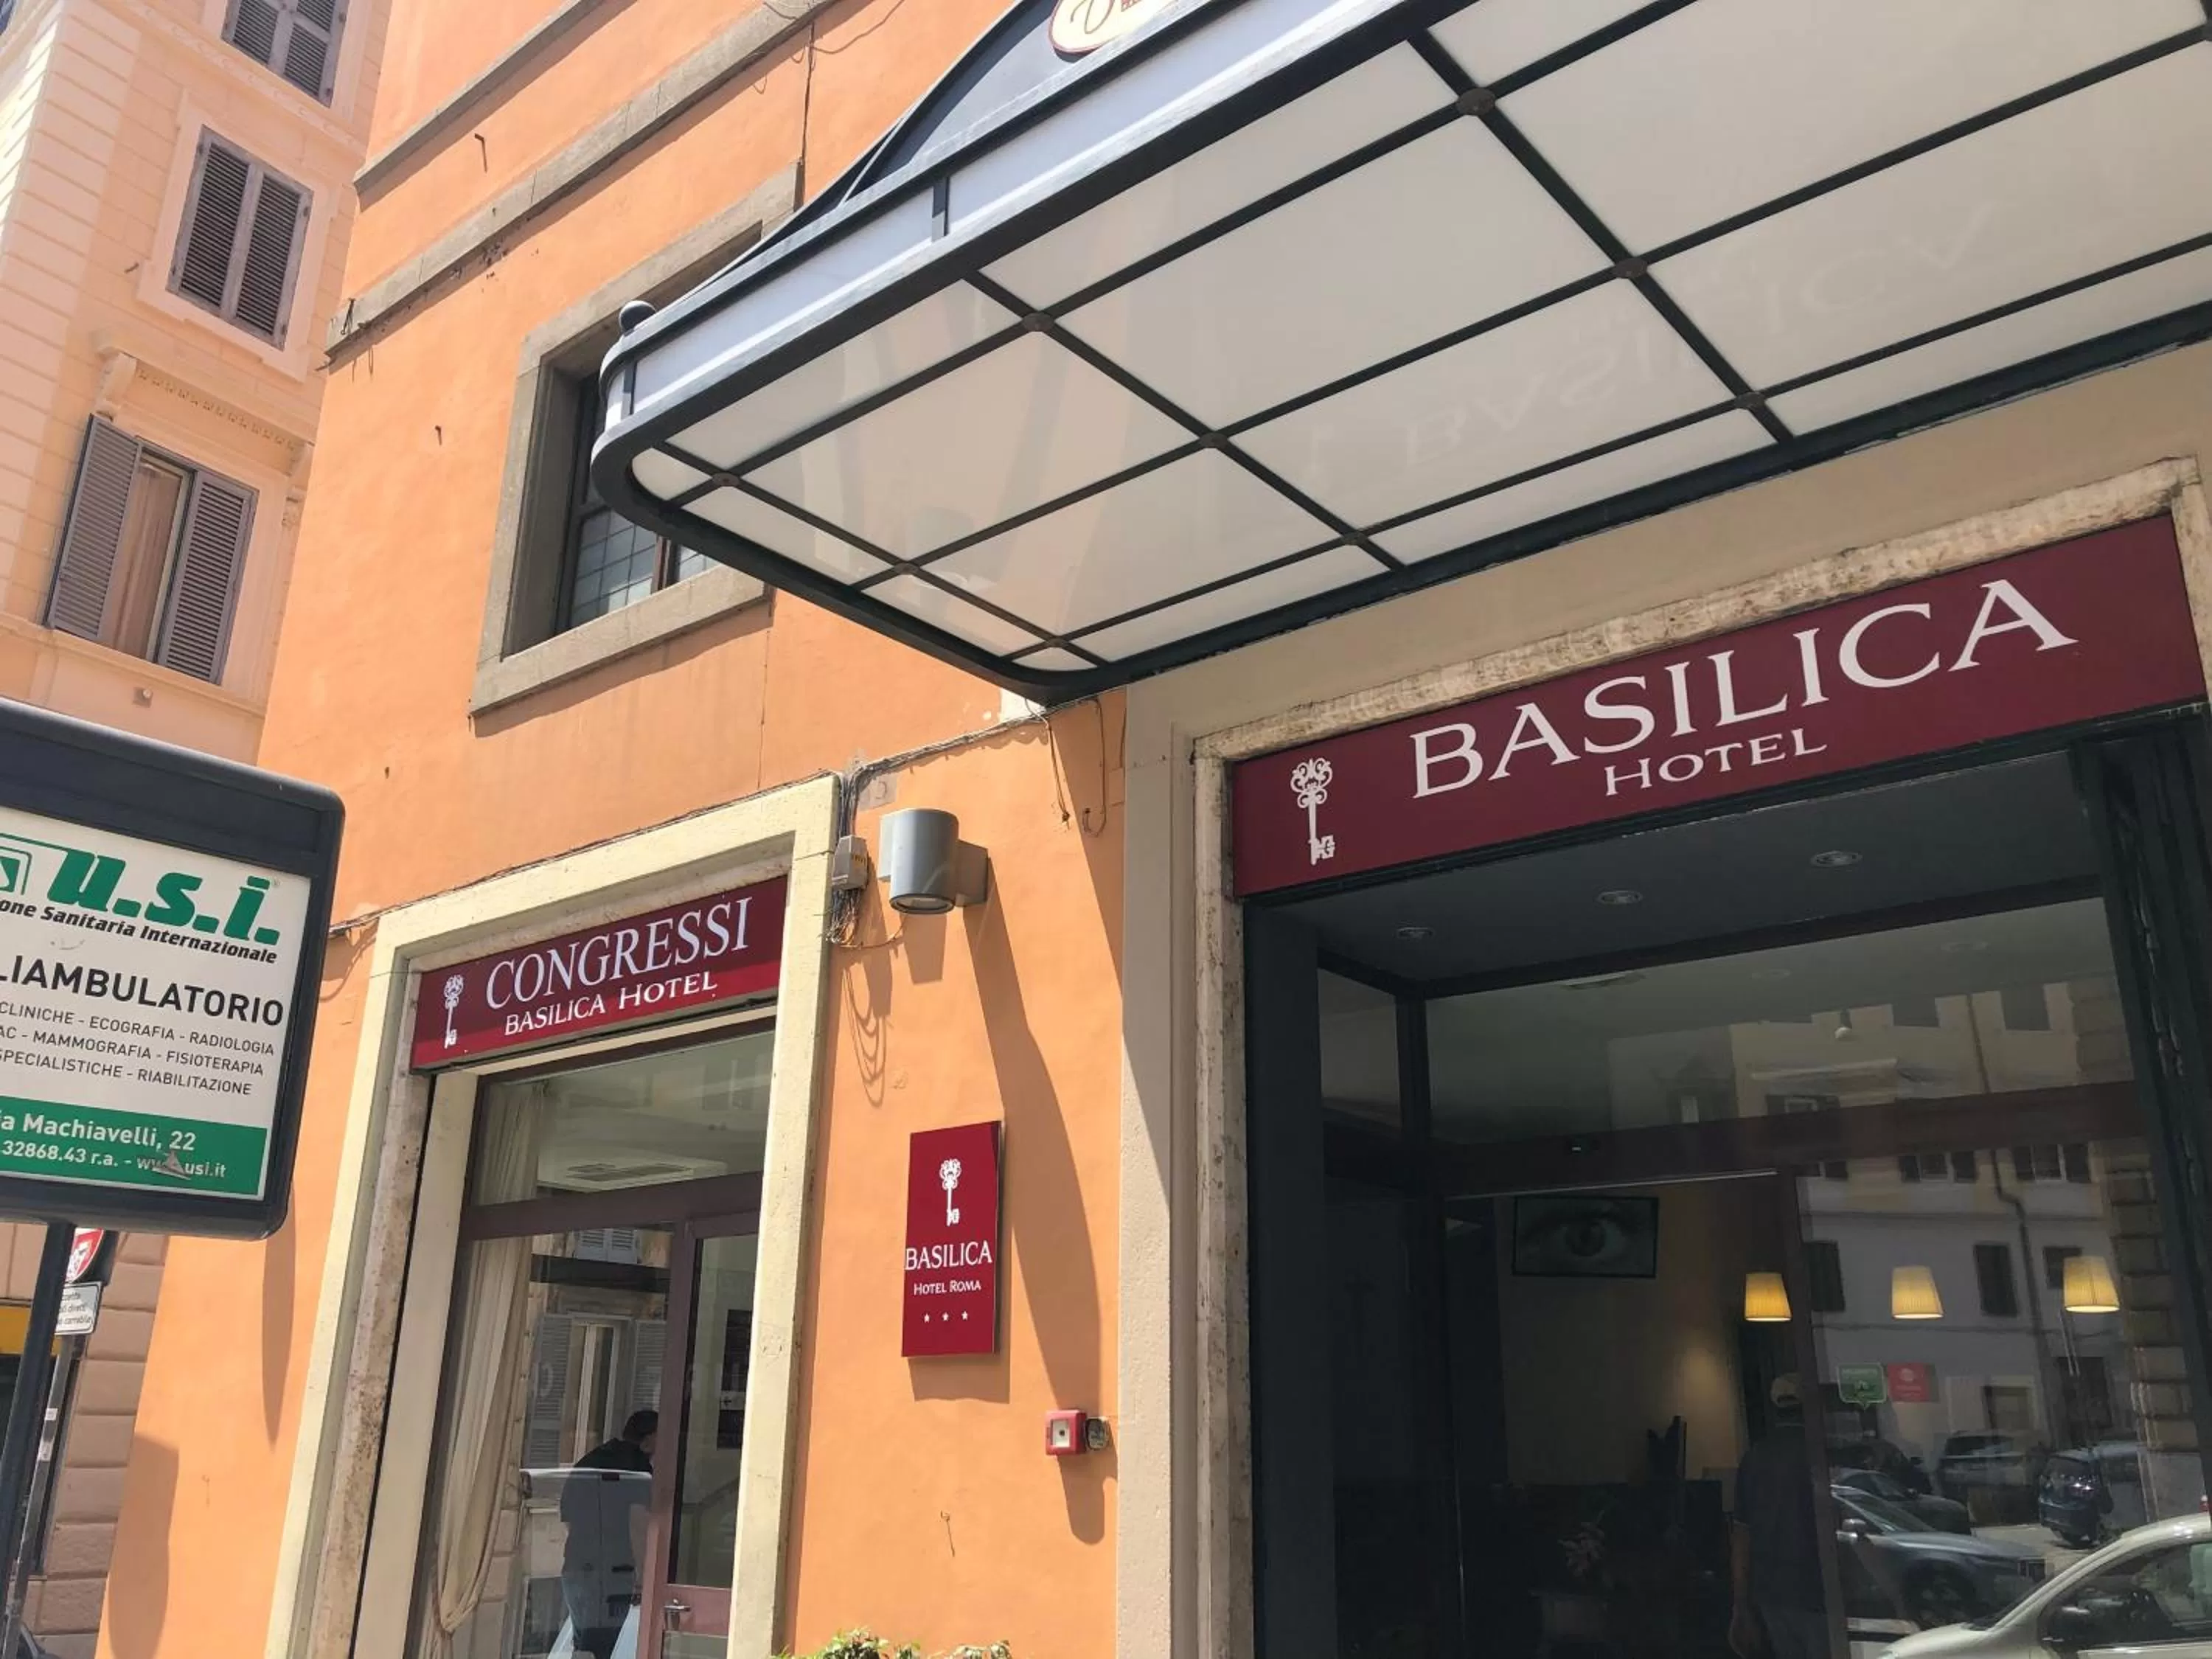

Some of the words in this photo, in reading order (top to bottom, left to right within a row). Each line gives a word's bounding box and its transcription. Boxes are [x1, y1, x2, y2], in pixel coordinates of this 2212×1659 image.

[1410, 579, 2078, 799] BASILICA
[40, 906, 136, 936] Sanitaria
[140, 926, 277, 964] Internazionale
[486, 897, 752, 1010] CONGRESSI
[505, 996, 605, 1036] BASILICA
[619, 972, 718, 1010] HOTEL
[32, 1030, 151, 1060] MAMMOGRAFIA
[166, 1051, 263, 1077] FISIOTERAPIA
[89, 1016, 175, 1040] ECOGRAFIA
[189, 1032, 274, 1056] RADIOLOGIA
[138, 1068, 252, 1095] RIABILITAZIONE
[2, 1140, 86, 1163] 32868.43
[23, 1113, 162, 1152] Machiavelli,
[169, 1130, 196, 1151] 22
[905, 1239, 992, 1270] BASILICA
